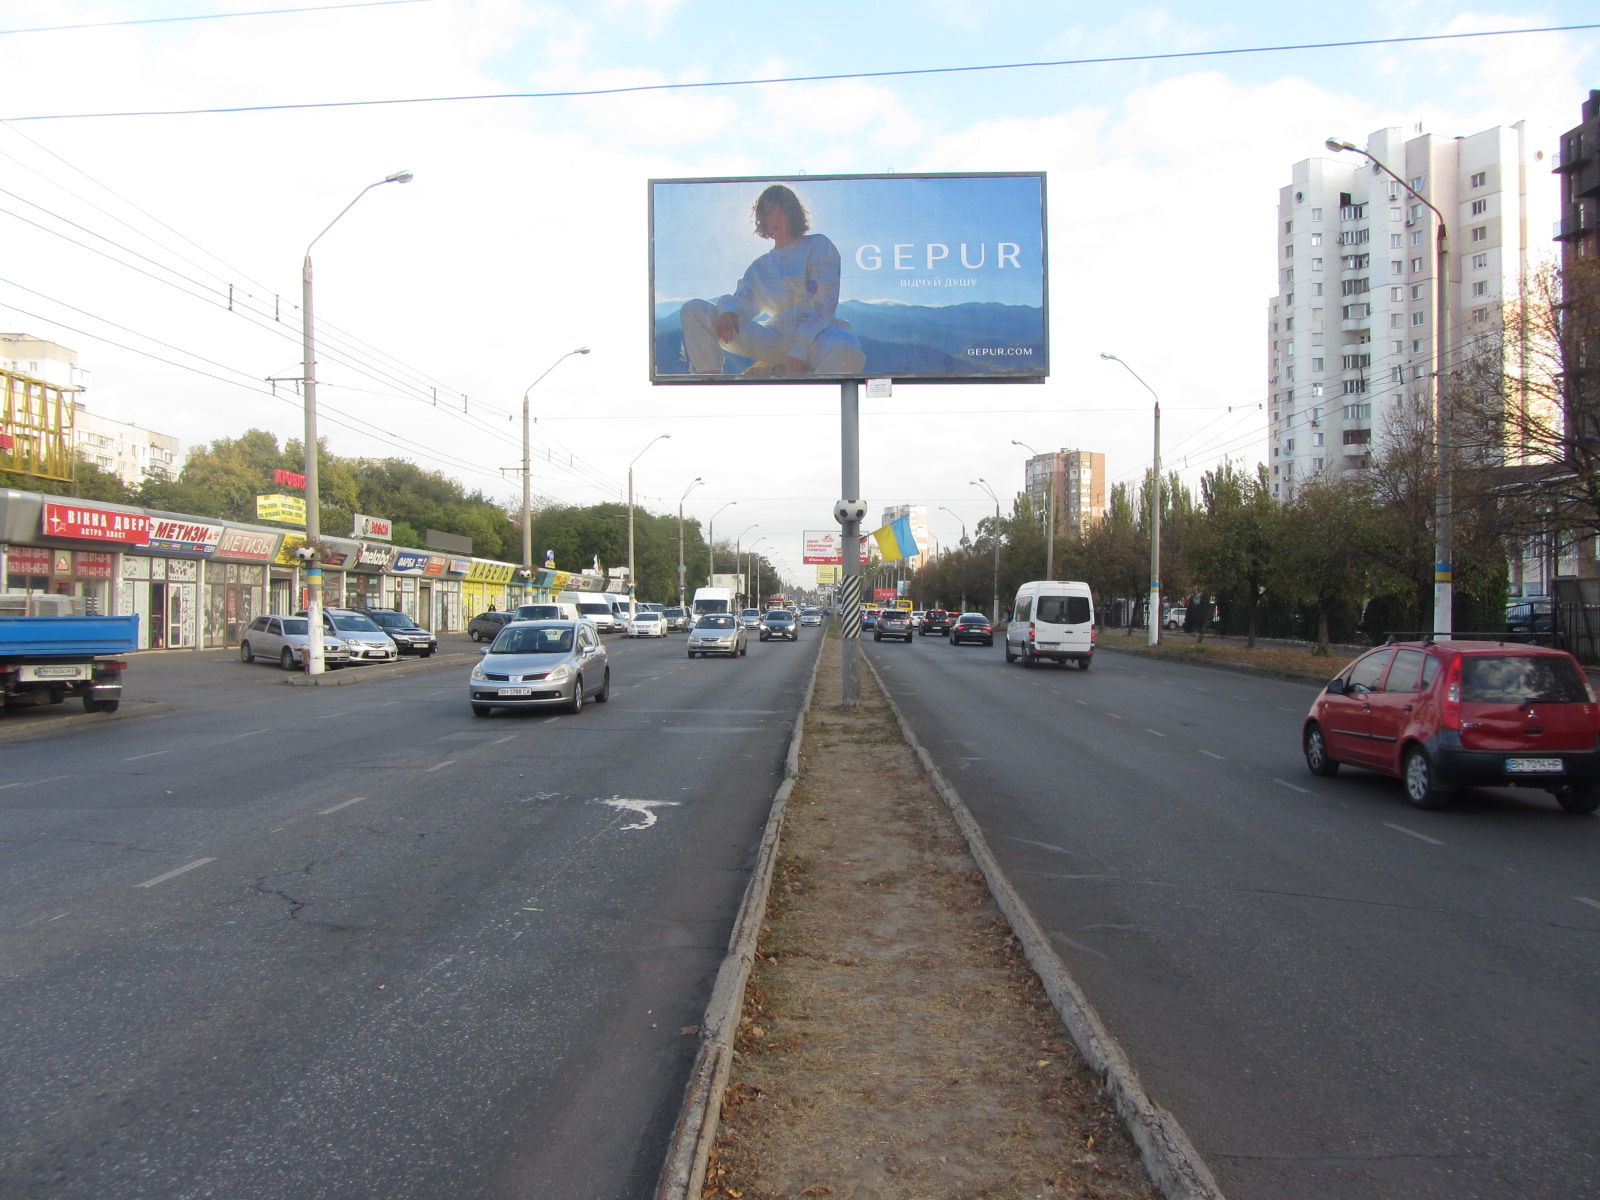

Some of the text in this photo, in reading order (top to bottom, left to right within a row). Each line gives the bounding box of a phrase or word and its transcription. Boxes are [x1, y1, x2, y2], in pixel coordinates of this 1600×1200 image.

[855, 242, 1022, 270] GEPUR
[900, 277, 978, 288] ВІДЧУЙ ДУШУ
[967, 347, 1033, 357] GEPUR.COM
[81, 527, 102, 536] АСТРА
[114, 515, 149, 532] ДВЕРІ
[154, 521, 210, 543] МЕТИЗИ
[220, 534, 275, 555] МЕТИЗЫ
[359, 547, 390, 566] metabo
[397, 556, 416, 568] ФАРБА
[470, 561, 510, 581] КАБЕЛЬ
